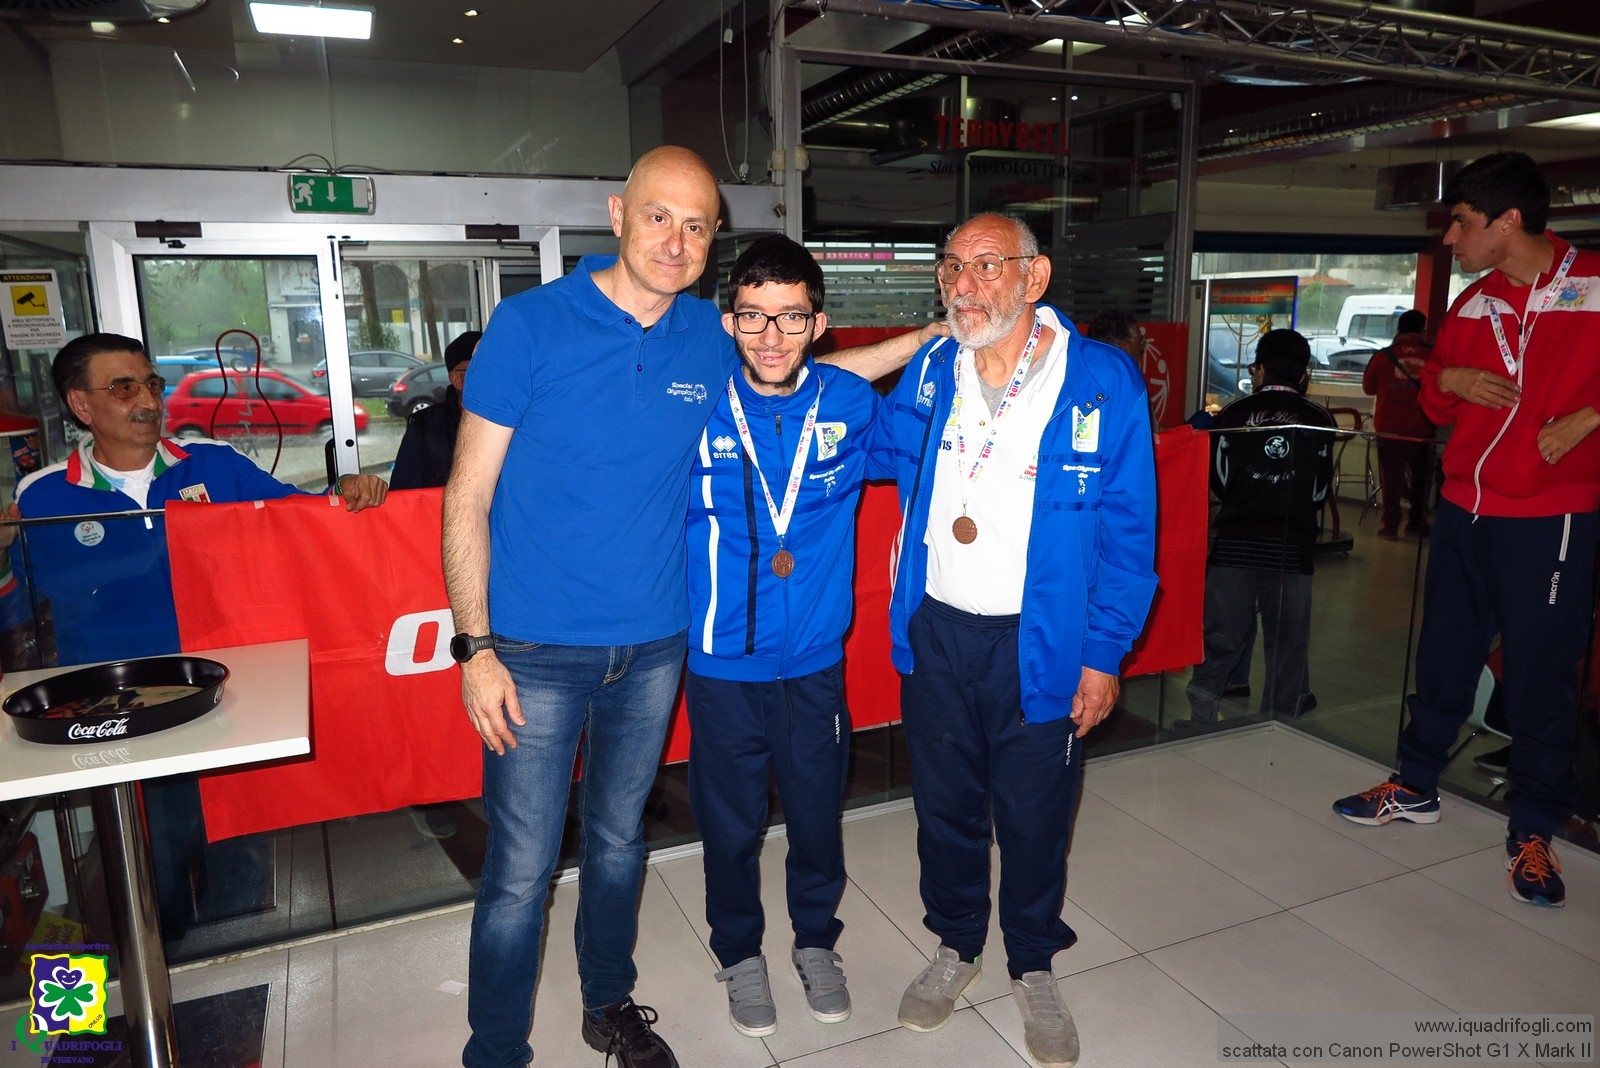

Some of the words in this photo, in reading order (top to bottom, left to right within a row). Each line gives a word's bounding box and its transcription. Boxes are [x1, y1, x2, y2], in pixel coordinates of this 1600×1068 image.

[934, 114, 1072, 155] TERRYBELL
[929, 160, 953, 175] Slot
[3, 274, 50, 282] ATTENZIONE!
[806, 414, 815, 432] 2019
[982, 440, 994, 459] 2019
[68, 717, 130, 740] Coca-Cola
